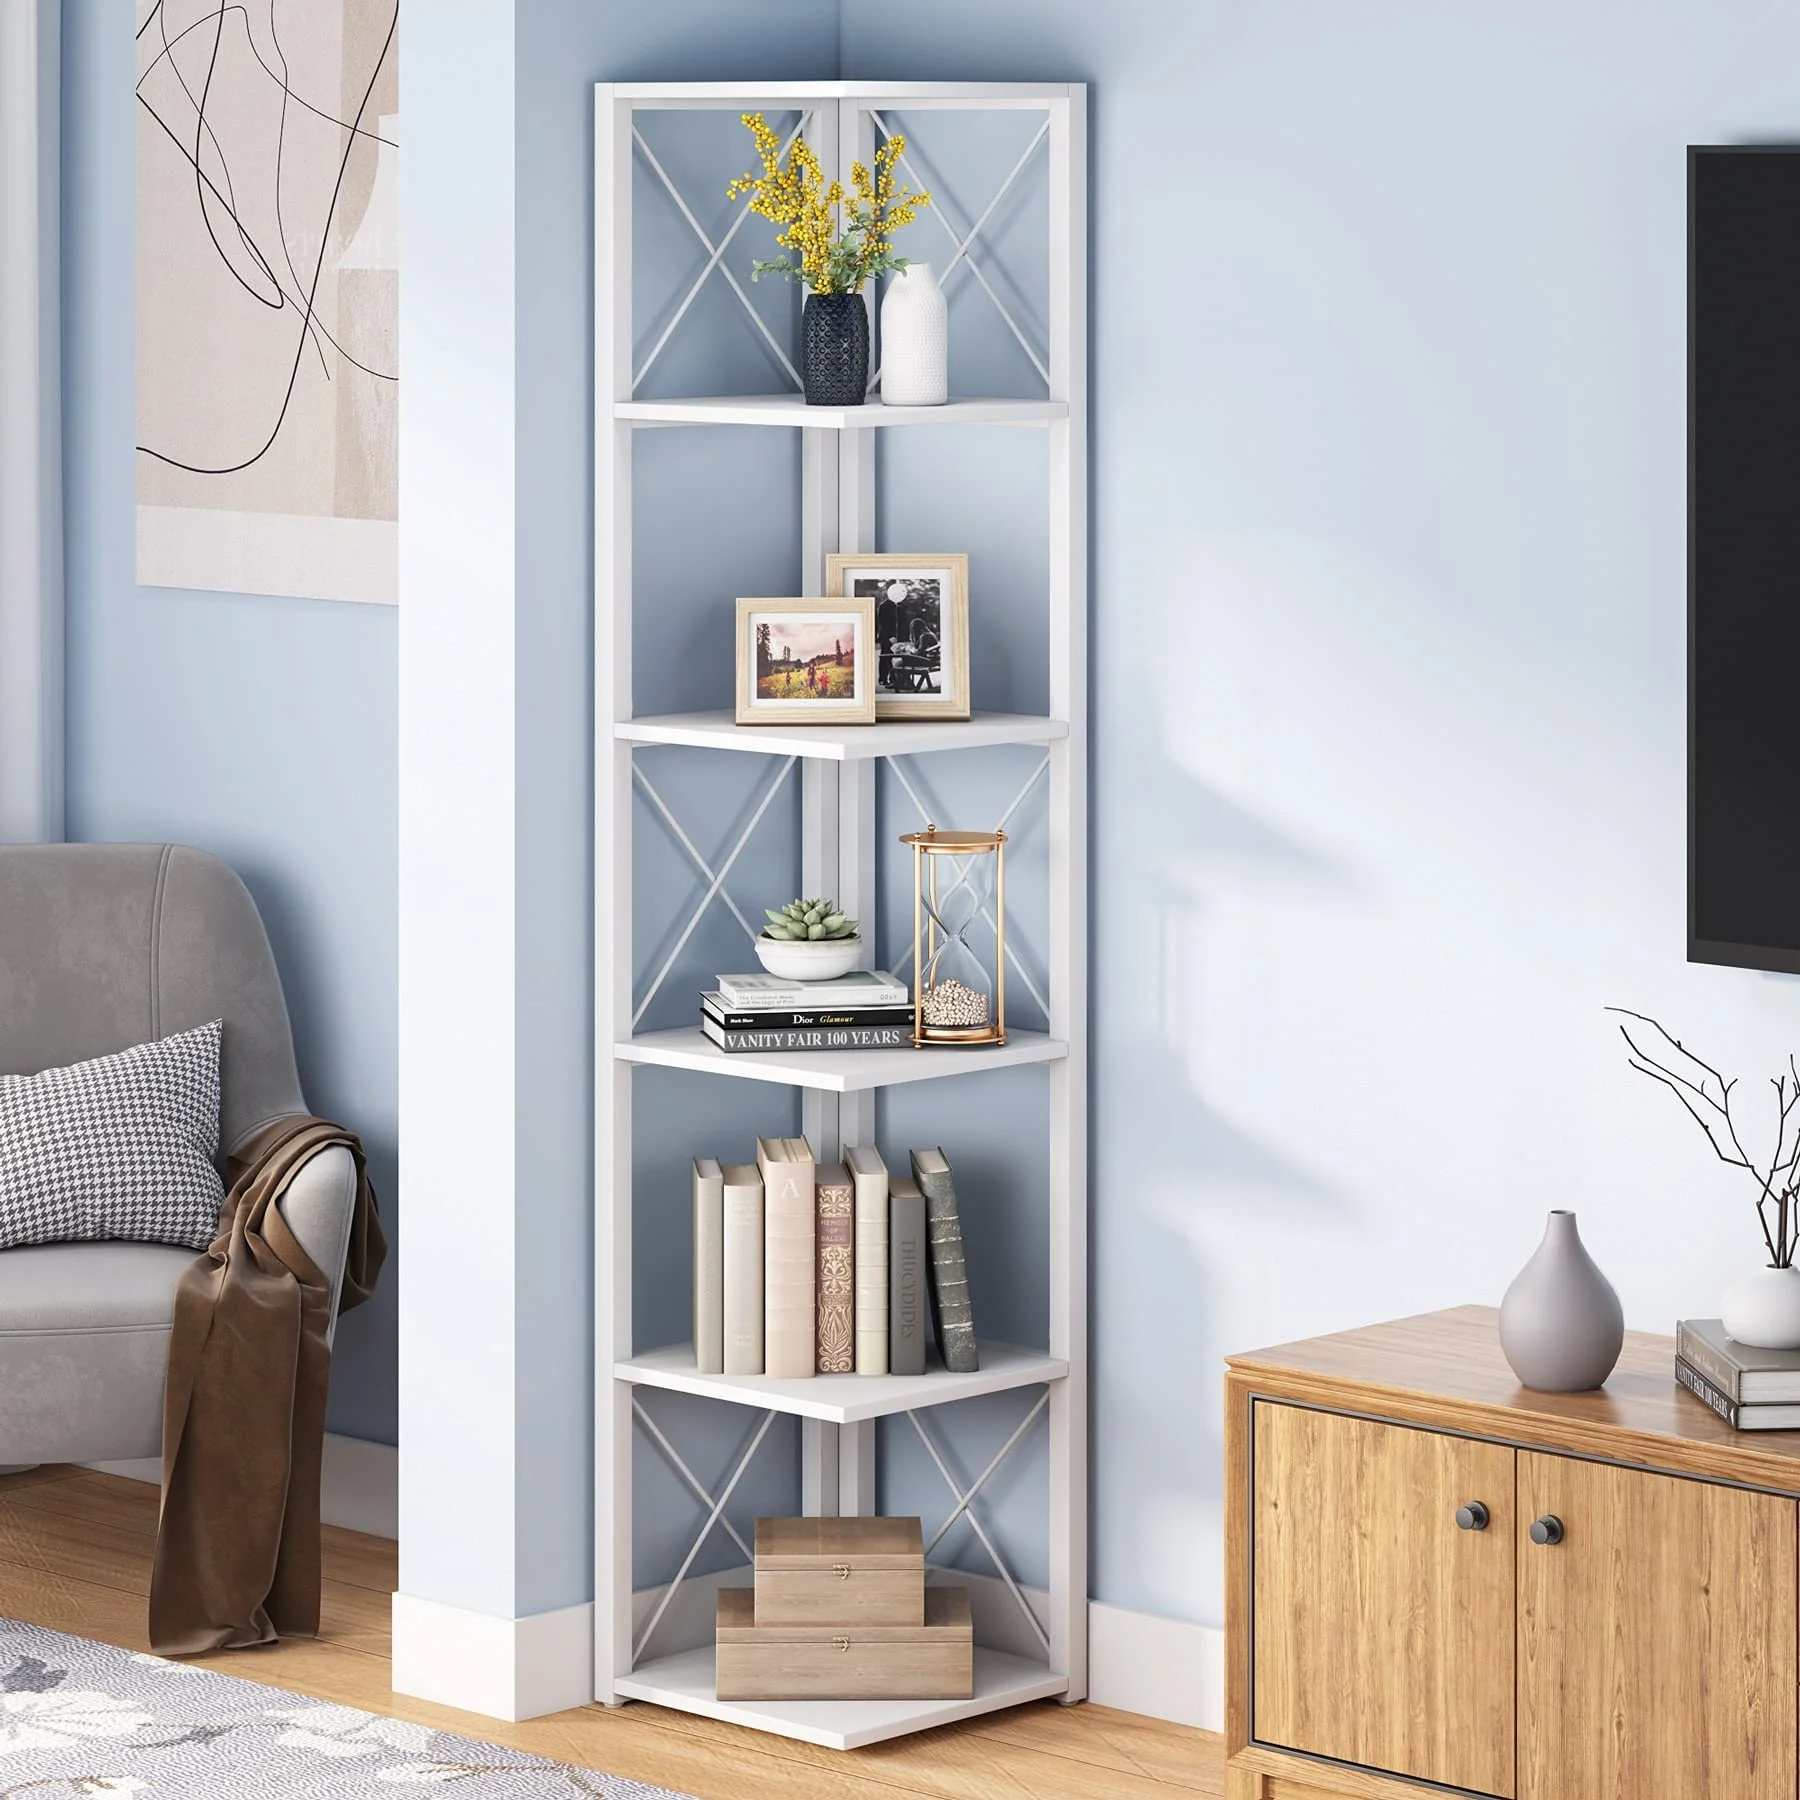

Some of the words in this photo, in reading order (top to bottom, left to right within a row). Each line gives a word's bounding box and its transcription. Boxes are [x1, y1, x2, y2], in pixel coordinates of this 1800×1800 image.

[792, 1014, 814, 1024] Dior
[819, 1015, 854, 1023] Glamour
[727, 1032, 784, 1048] VANITY
[788, 1032, 822, 1047] FAIR
[826, 1031, 847, 1045] 100
[852, 1030, 900, 1045] YEARS
[781, 1178, 801, 1198] A
[901, 1237, 916, 1339] THUCYDIDES
